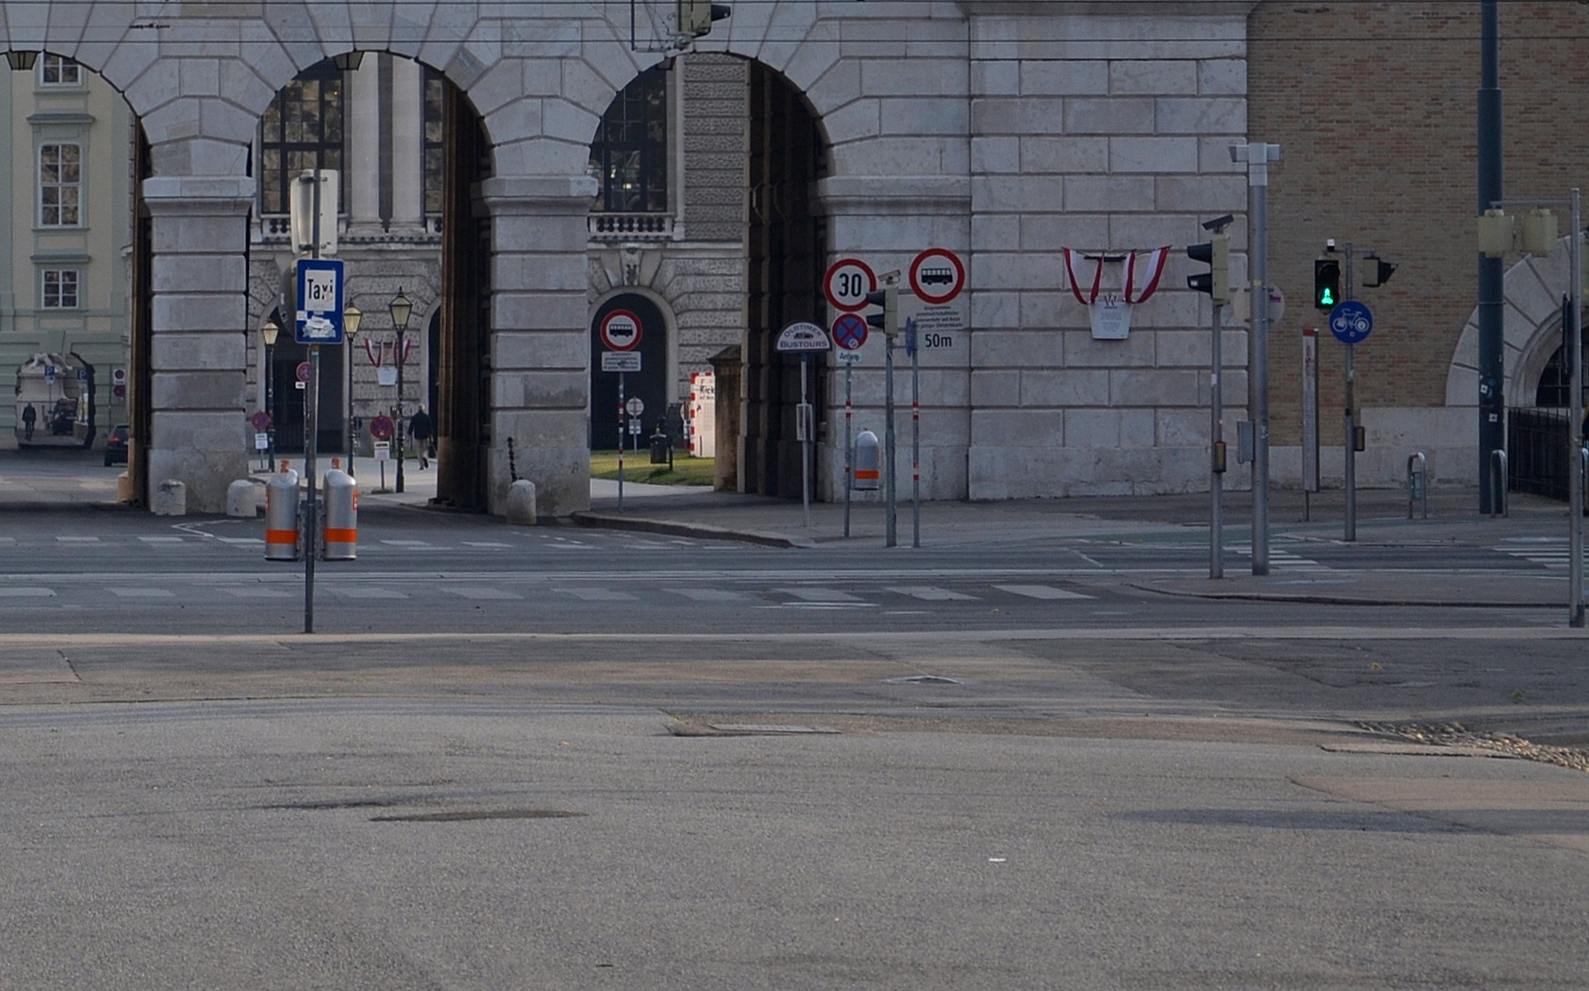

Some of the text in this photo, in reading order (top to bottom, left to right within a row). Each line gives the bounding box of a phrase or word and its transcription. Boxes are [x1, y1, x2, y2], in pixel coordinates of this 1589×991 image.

[307, 279, 333, 300] Taxi
[838, 272, 862, 297] 30
[783, 324, 822, 338] OLDTIMER
[925, 333, 952, 348] 50m
